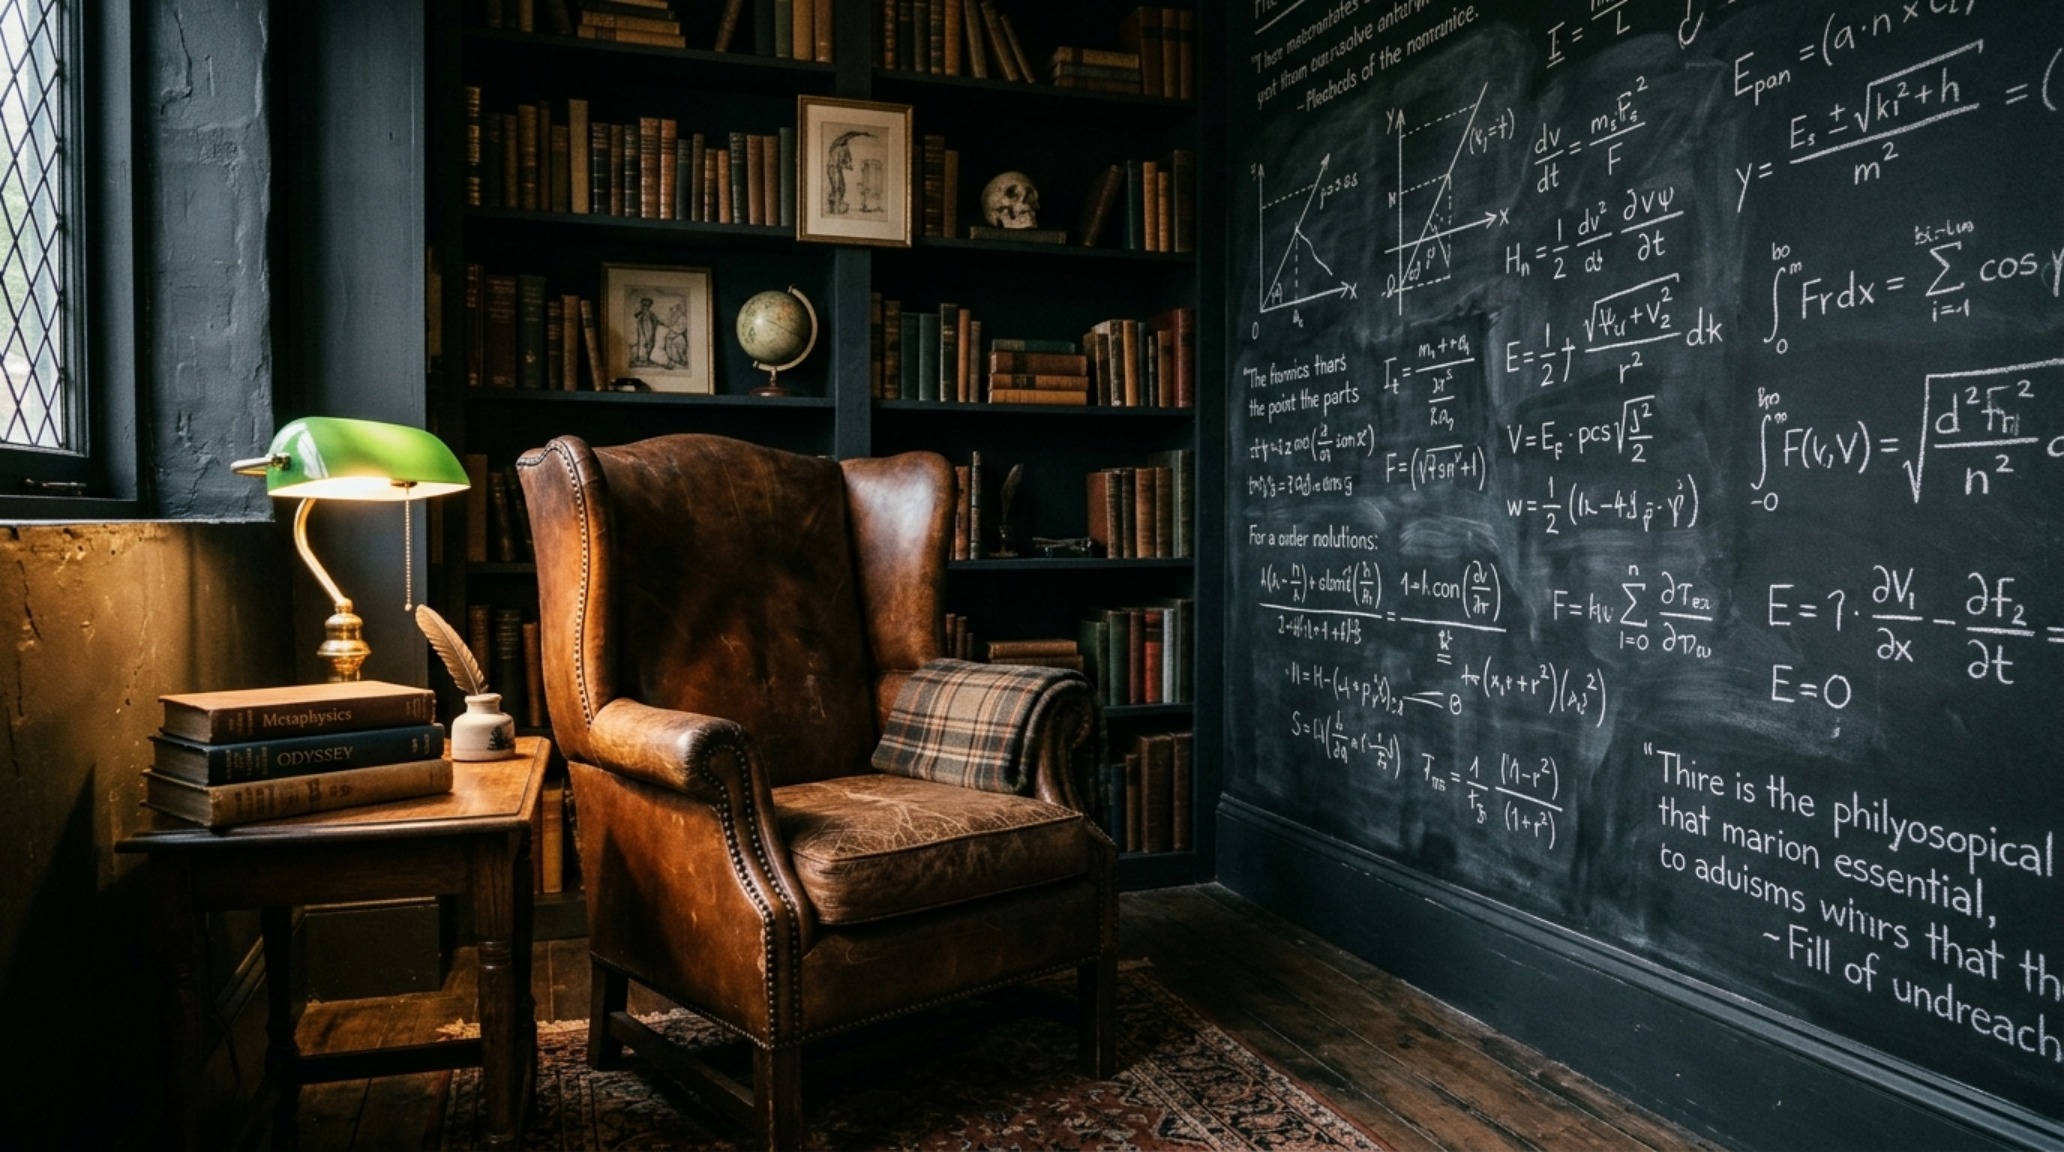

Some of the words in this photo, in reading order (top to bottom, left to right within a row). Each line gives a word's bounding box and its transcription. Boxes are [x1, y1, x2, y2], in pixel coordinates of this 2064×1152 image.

[1323, 379, 1360, 418] parts
[276, 746, 354, 768] ODYSSEY
[1735, 771, 1756, 804] is
[1765, 774, 1816, 818] the
[1657, 796, 1711, 837] that
[1722, 819, 1820, 869] marion
[1834, 852, 1998, 930] essential,
[1660, 842, 1686, 871] to
[1694, 855, 1806, 914] aduisms
[1924, 921, 2006, 981] that
[2018, 948, 2064, 1003] th
[1844, 952, 1881, 993] of
